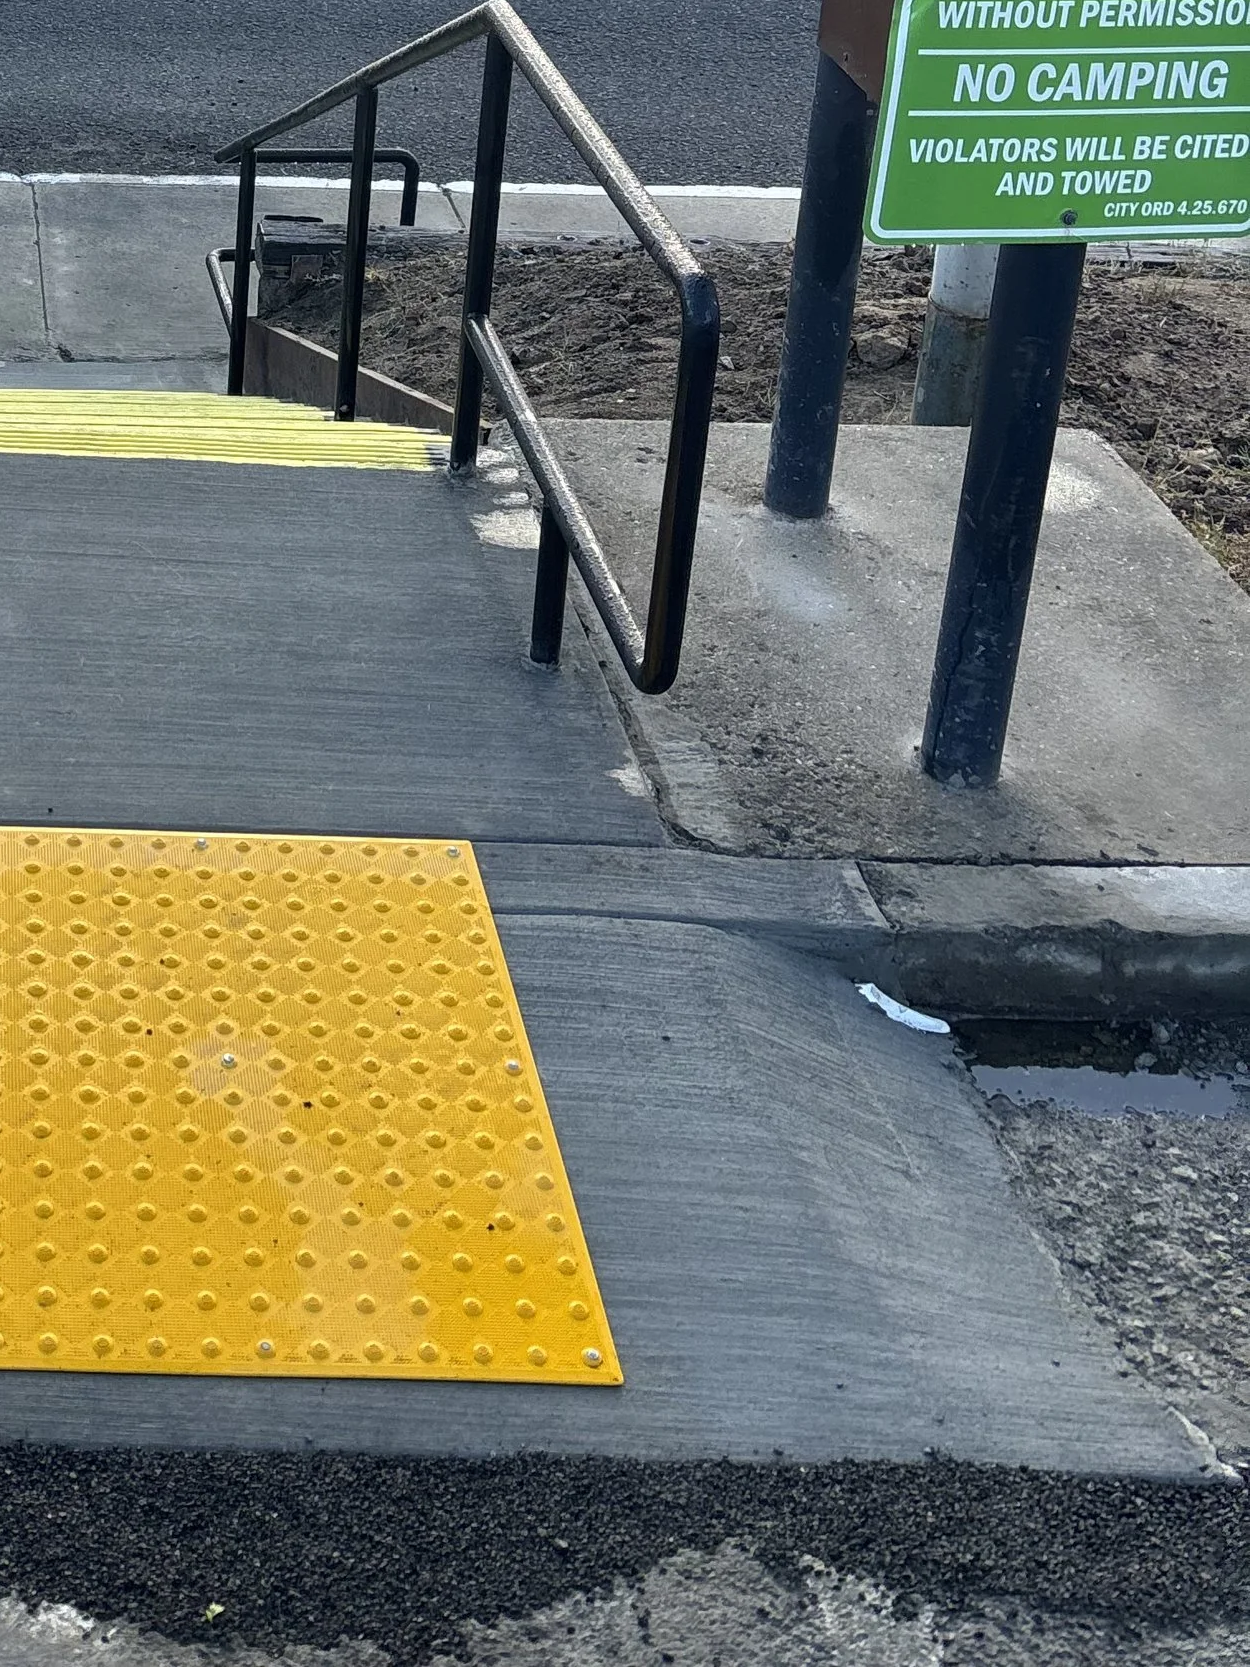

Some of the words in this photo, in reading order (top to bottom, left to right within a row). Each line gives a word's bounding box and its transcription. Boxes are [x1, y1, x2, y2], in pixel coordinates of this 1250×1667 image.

[939, 0, 1075, 29] WITHOUT
[954, 63, 1015, 102] NO
[1028, 60, 1228, 102] CAMPING
[910, 138, 1057, 162] VIOLATORS
[1066, 137, 1125, 161] WILL
[1133, 136, 1170, 159] BE
[1175, 134, 1250, 159] CITED
[995, 172, 1053, 195] AND
[1062, 170, 1152, 194] TOWED
[1105, 202, 1139, 218] CITY
[1142, 202, 1174, 216] ORD
[1177, 200, 1248, 216] 4.25.670
